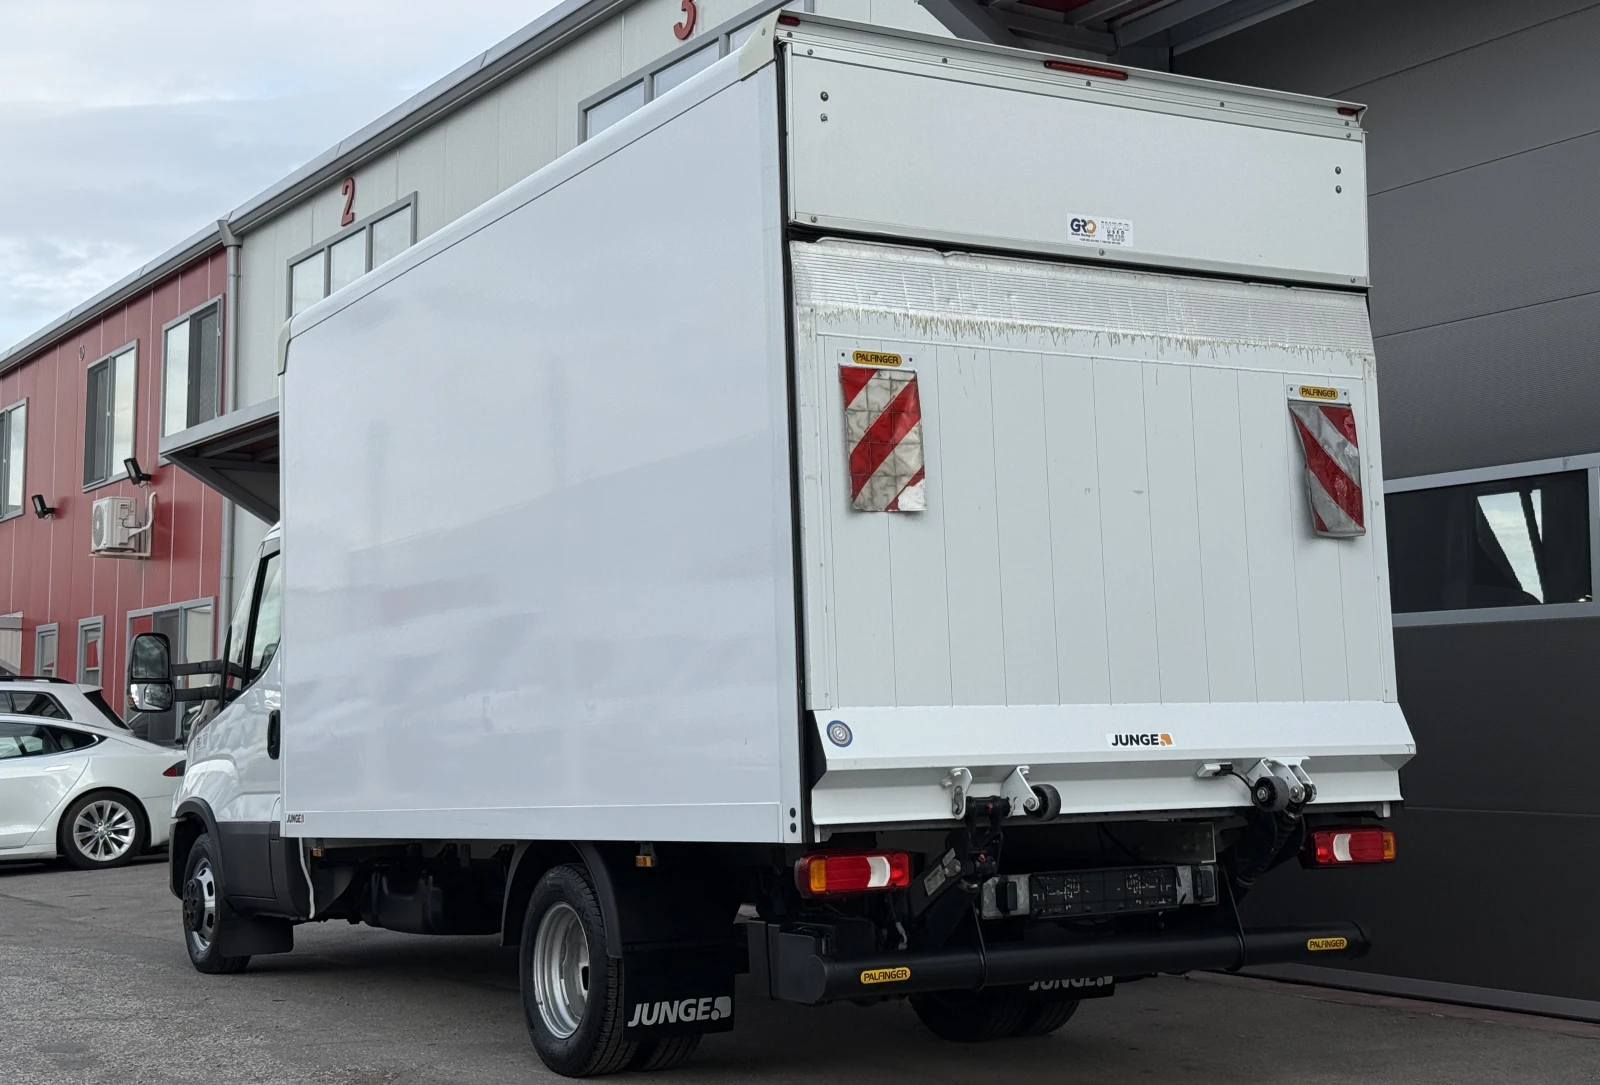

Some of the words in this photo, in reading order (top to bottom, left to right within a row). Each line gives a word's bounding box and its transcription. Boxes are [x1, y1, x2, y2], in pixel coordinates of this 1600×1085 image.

[341, 177, 355, 227] 2
[1070, 217, 1097, 234] GRO
[855, 352, 899, 364] PALFINGER
[1301, 387, 1336, 398] PALFINGER
[1111, 733, 1160, 747] JUNGE
[1309, 939, 1345, 949] PALFINGER
[863, 969, 908, 982] PALFINGER
[627, 997, 713, 1027] JUNGE
